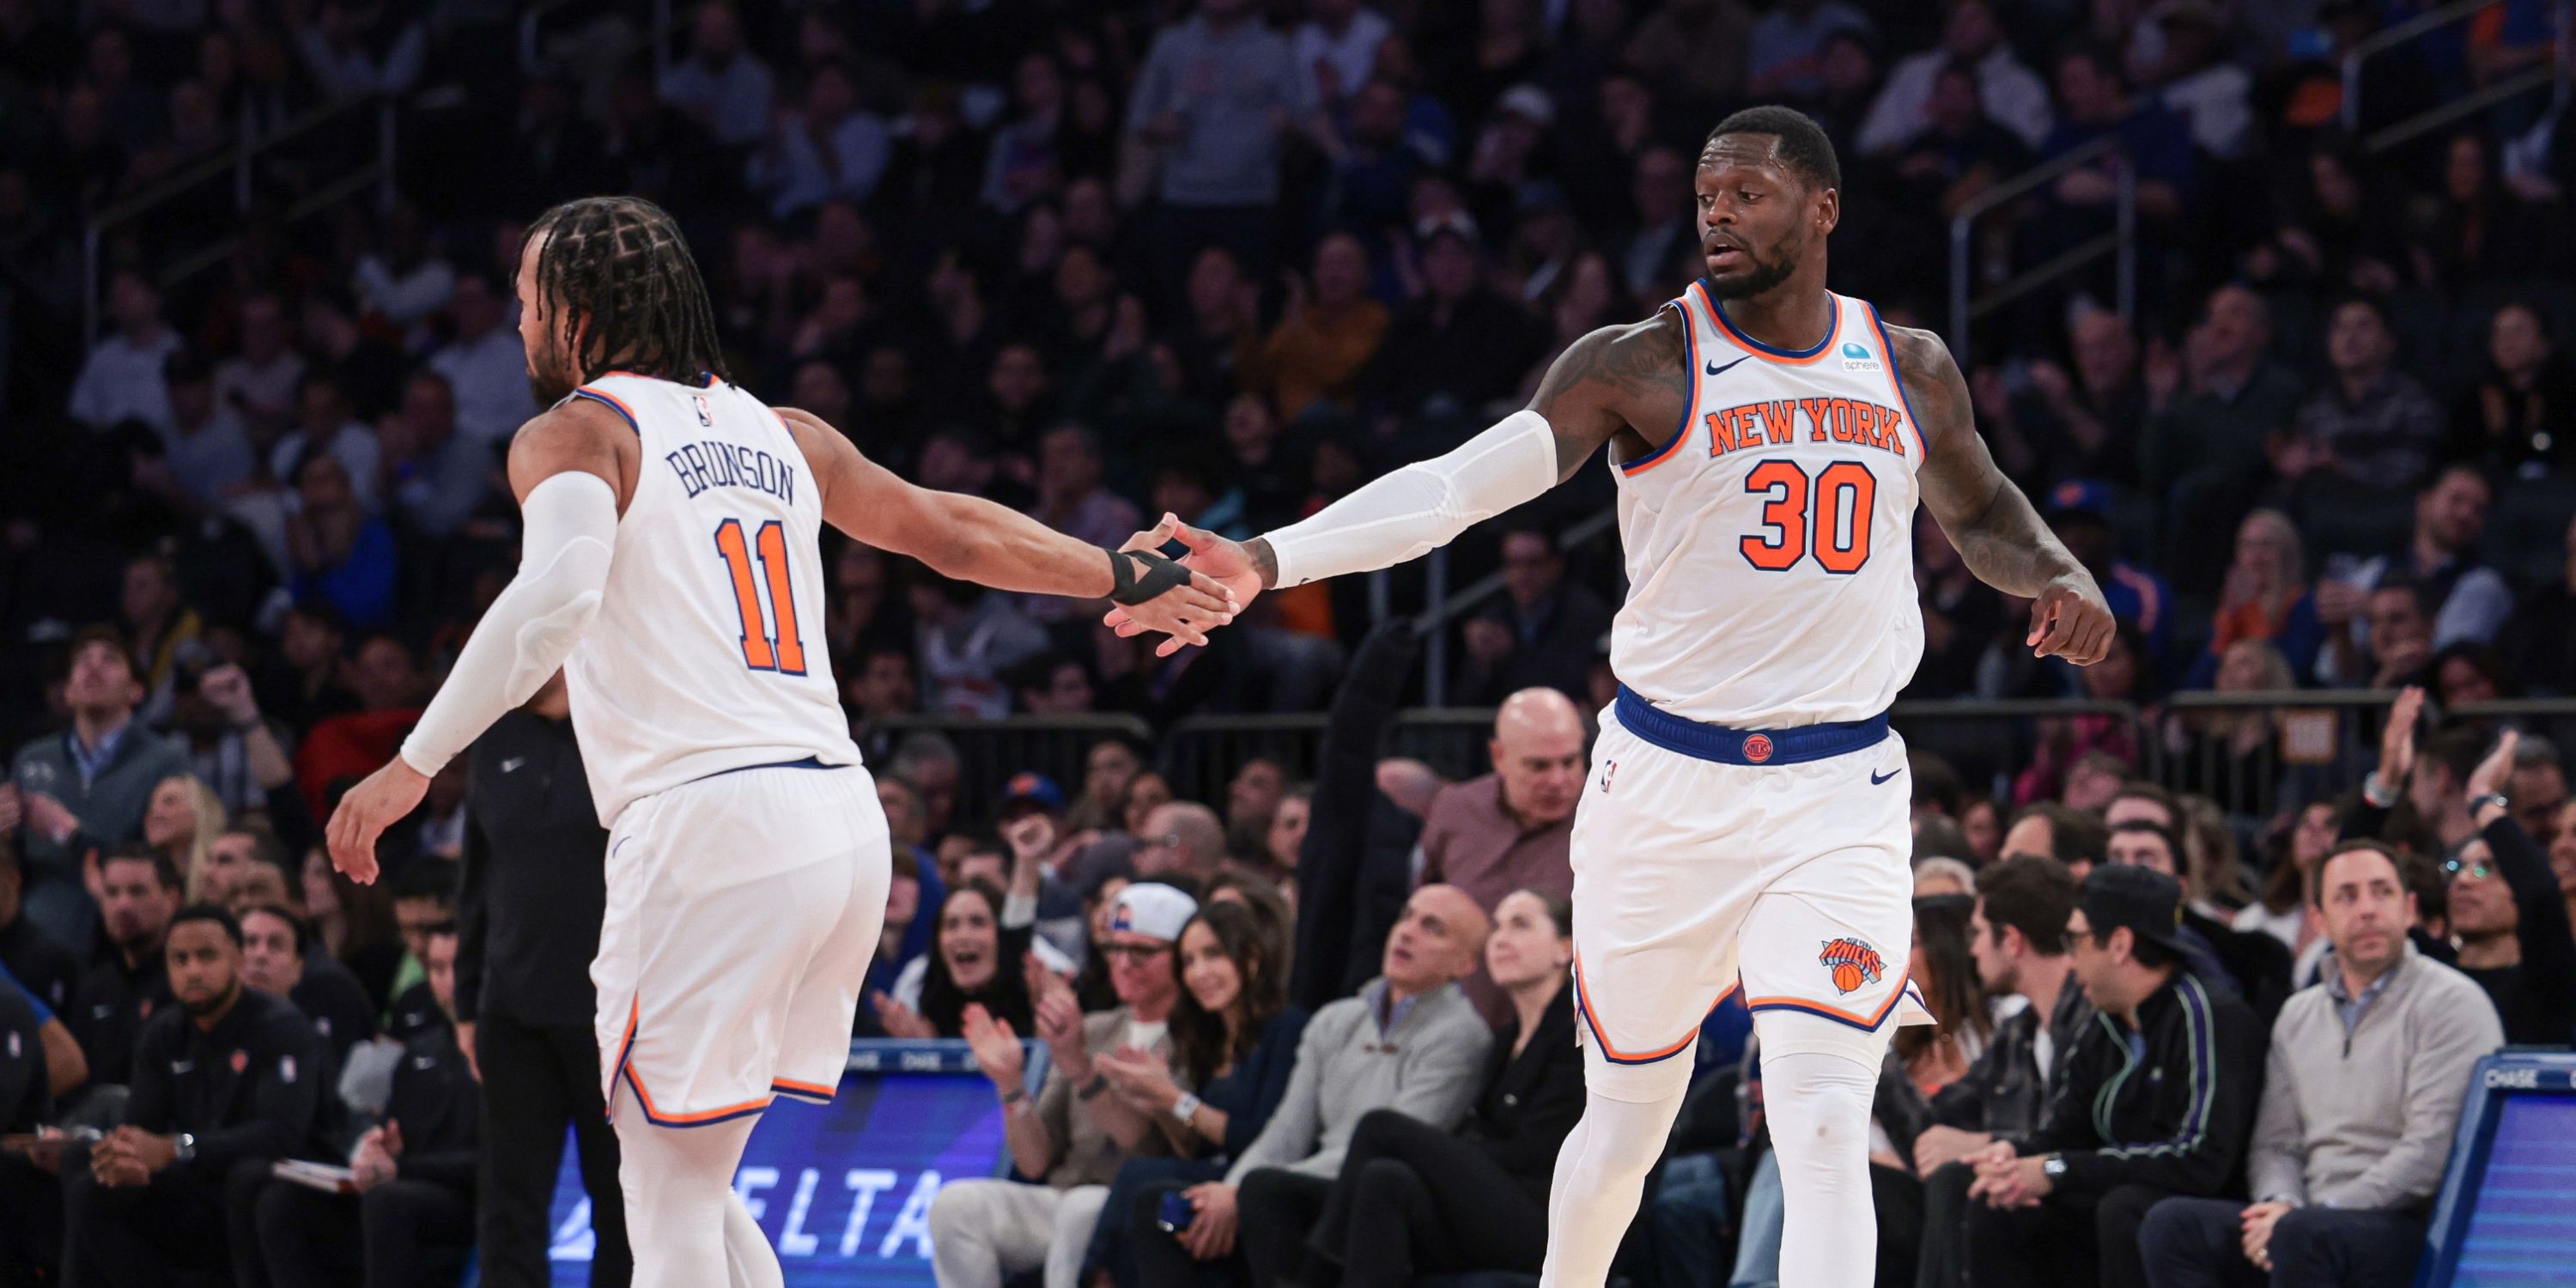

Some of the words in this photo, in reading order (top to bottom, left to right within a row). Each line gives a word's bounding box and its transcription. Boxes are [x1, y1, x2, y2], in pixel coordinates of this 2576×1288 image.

[1844, 361, 1880, 370] sphere
[1704, 398, 1796, 459] NEW
[1799, 397, 1905, 458] YORK
[665, 440, 793, 507] BRUNSON
[1739, 459, 1877, 574] 30
[714, 517, 808, 677] 11
[1819, 938, 1881, 982] KNICKS
[2484, 1068, 2538, 1089] CHASE
[735, 1166, 942, 1259] ELTA
